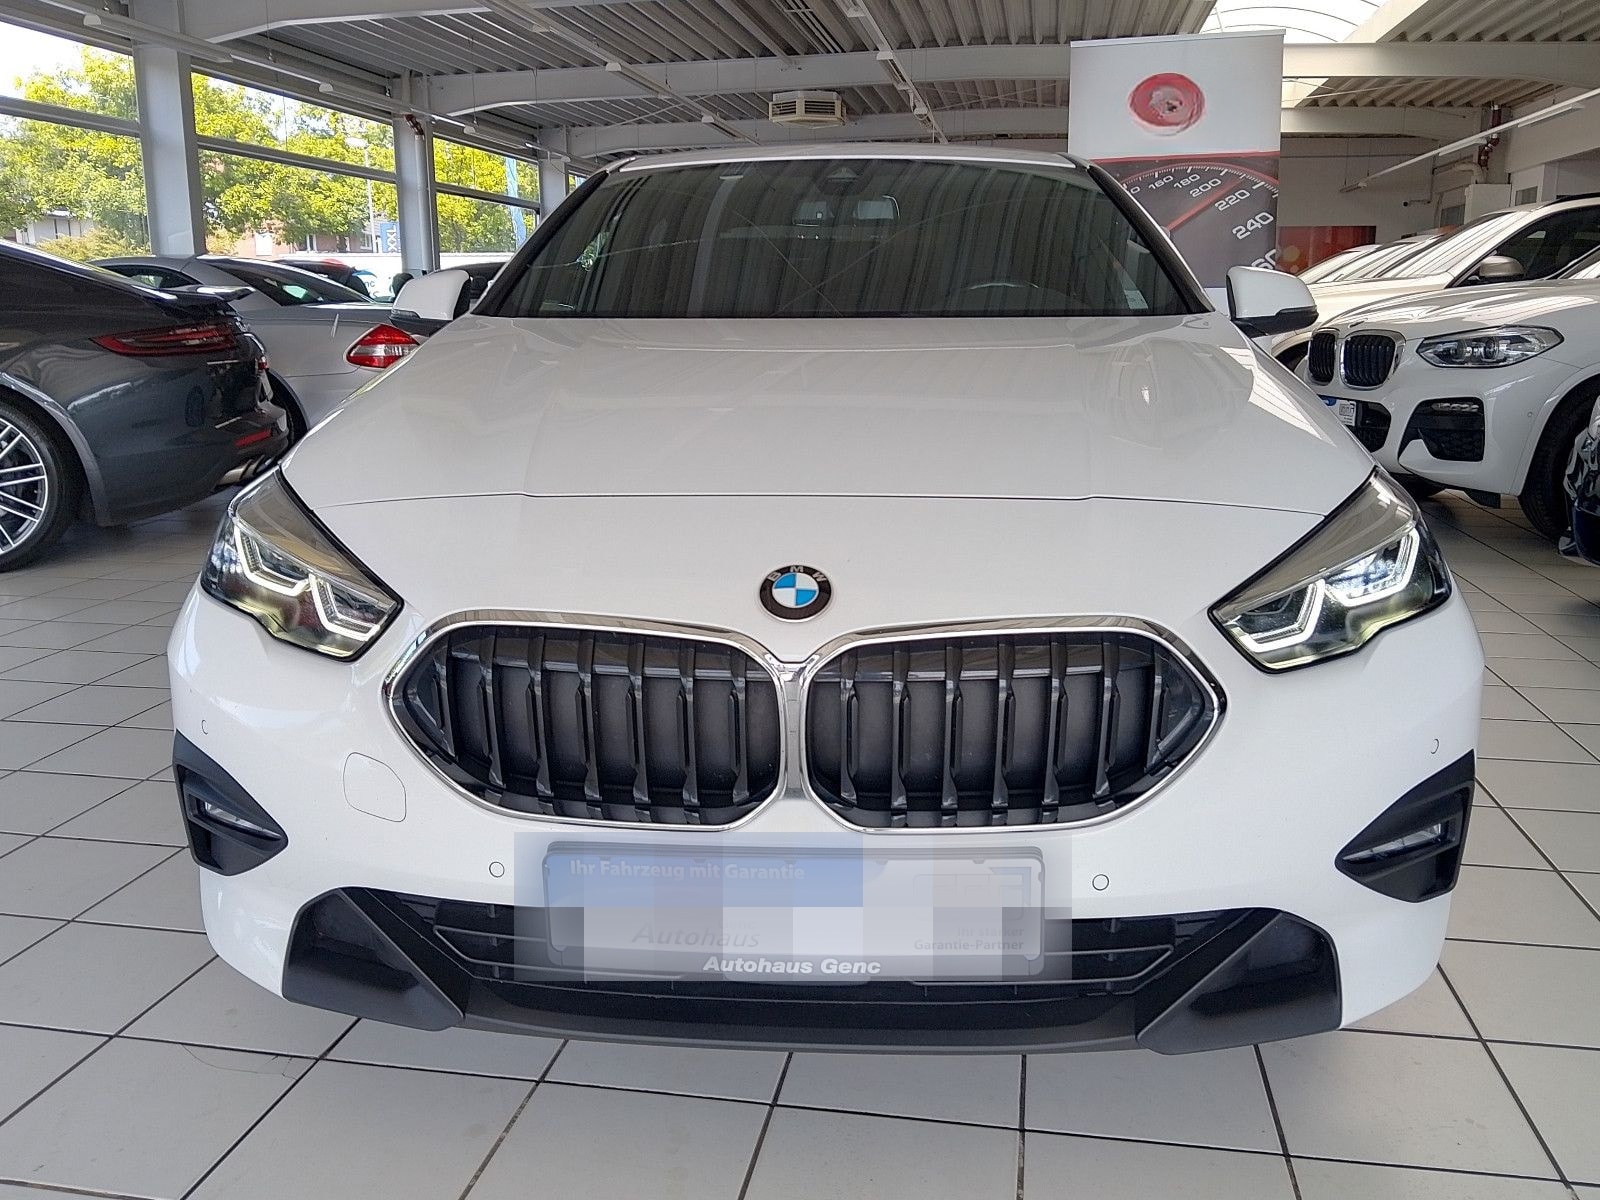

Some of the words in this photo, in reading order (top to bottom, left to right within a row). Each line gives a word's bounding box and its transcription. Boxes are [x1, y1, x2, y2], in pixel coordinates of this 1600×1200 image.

[1148, 175, 1174, 190] 160
[1173, 173, 1200, 189] 180
[1189, 178, 1222, 198] 200
[1214, 189, 1250, 212] 220
[1232, 212, 1274, 240] 240
[767, 565, 827, 582] BMW
[570, 860, 595, 875] Ihr
[600, 860, 684, 880] Fahrzeug
[690, 862, 721, 879] mit
[724, 863, 805, 880] Garantie
[632, 921, 760, 948] Autohaus
[913, 938, 1025, 950] Garantie-Partner
[702, 955, 814, 974] Autohaus
[820, 957, 882, 975] Genc
